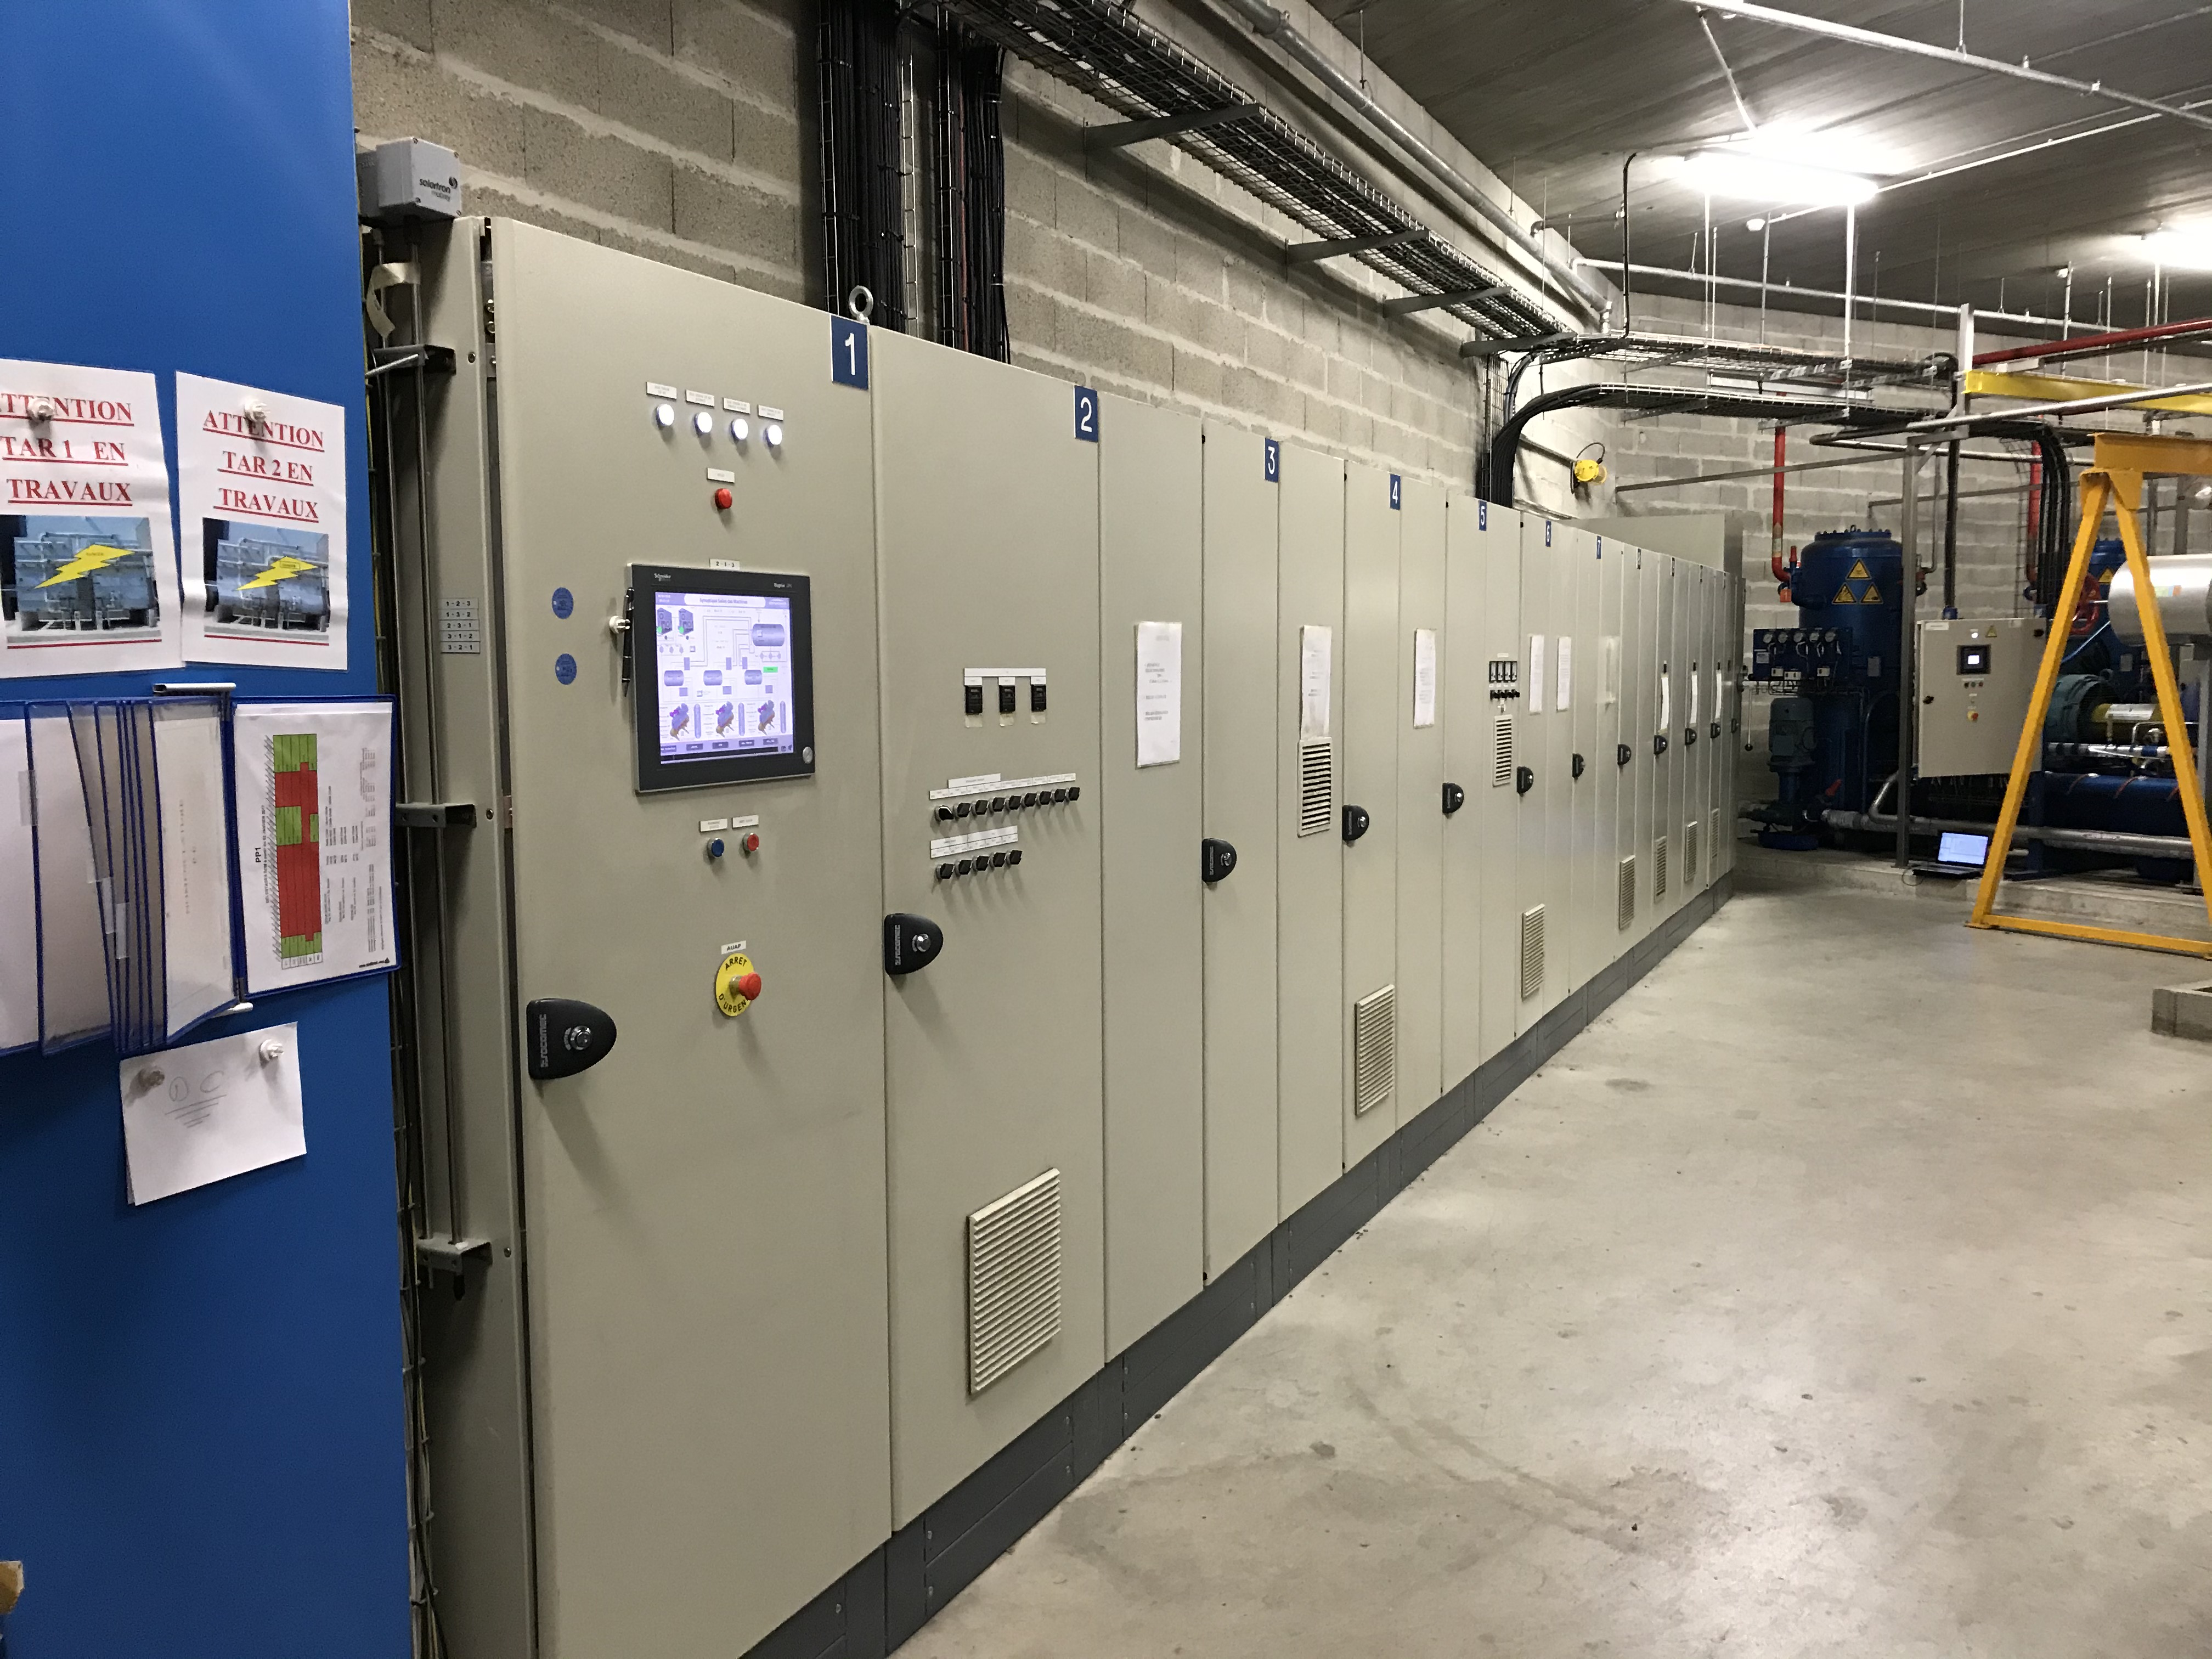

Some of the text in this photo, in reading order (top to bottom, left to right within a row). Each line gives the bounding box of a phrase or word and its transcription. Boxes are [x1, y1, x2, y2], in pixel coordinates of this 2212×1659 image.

[845, 332, 856, 376] 1
[0, 393, 132, 421] TTNTION
[1080, 397, 1092, 432] 2
[204, 409, 324, 448] ATTENTION
[0, 436, 125, 461] TAR 1 EN
[1268, 447, 1275, 474] 3
[223, 450, 313, 481] TAR 2 EN
[7, 478, 132, 501] TRAVAUX
[218, 487, 318, 518] TRAVAUX
[1392, 481, 1398, 504] 4
[1481, 505, 1485, 526] 5
[725, 956, 747, 971] ARRET
[719, 993, 749, 1013] D'URGEN
